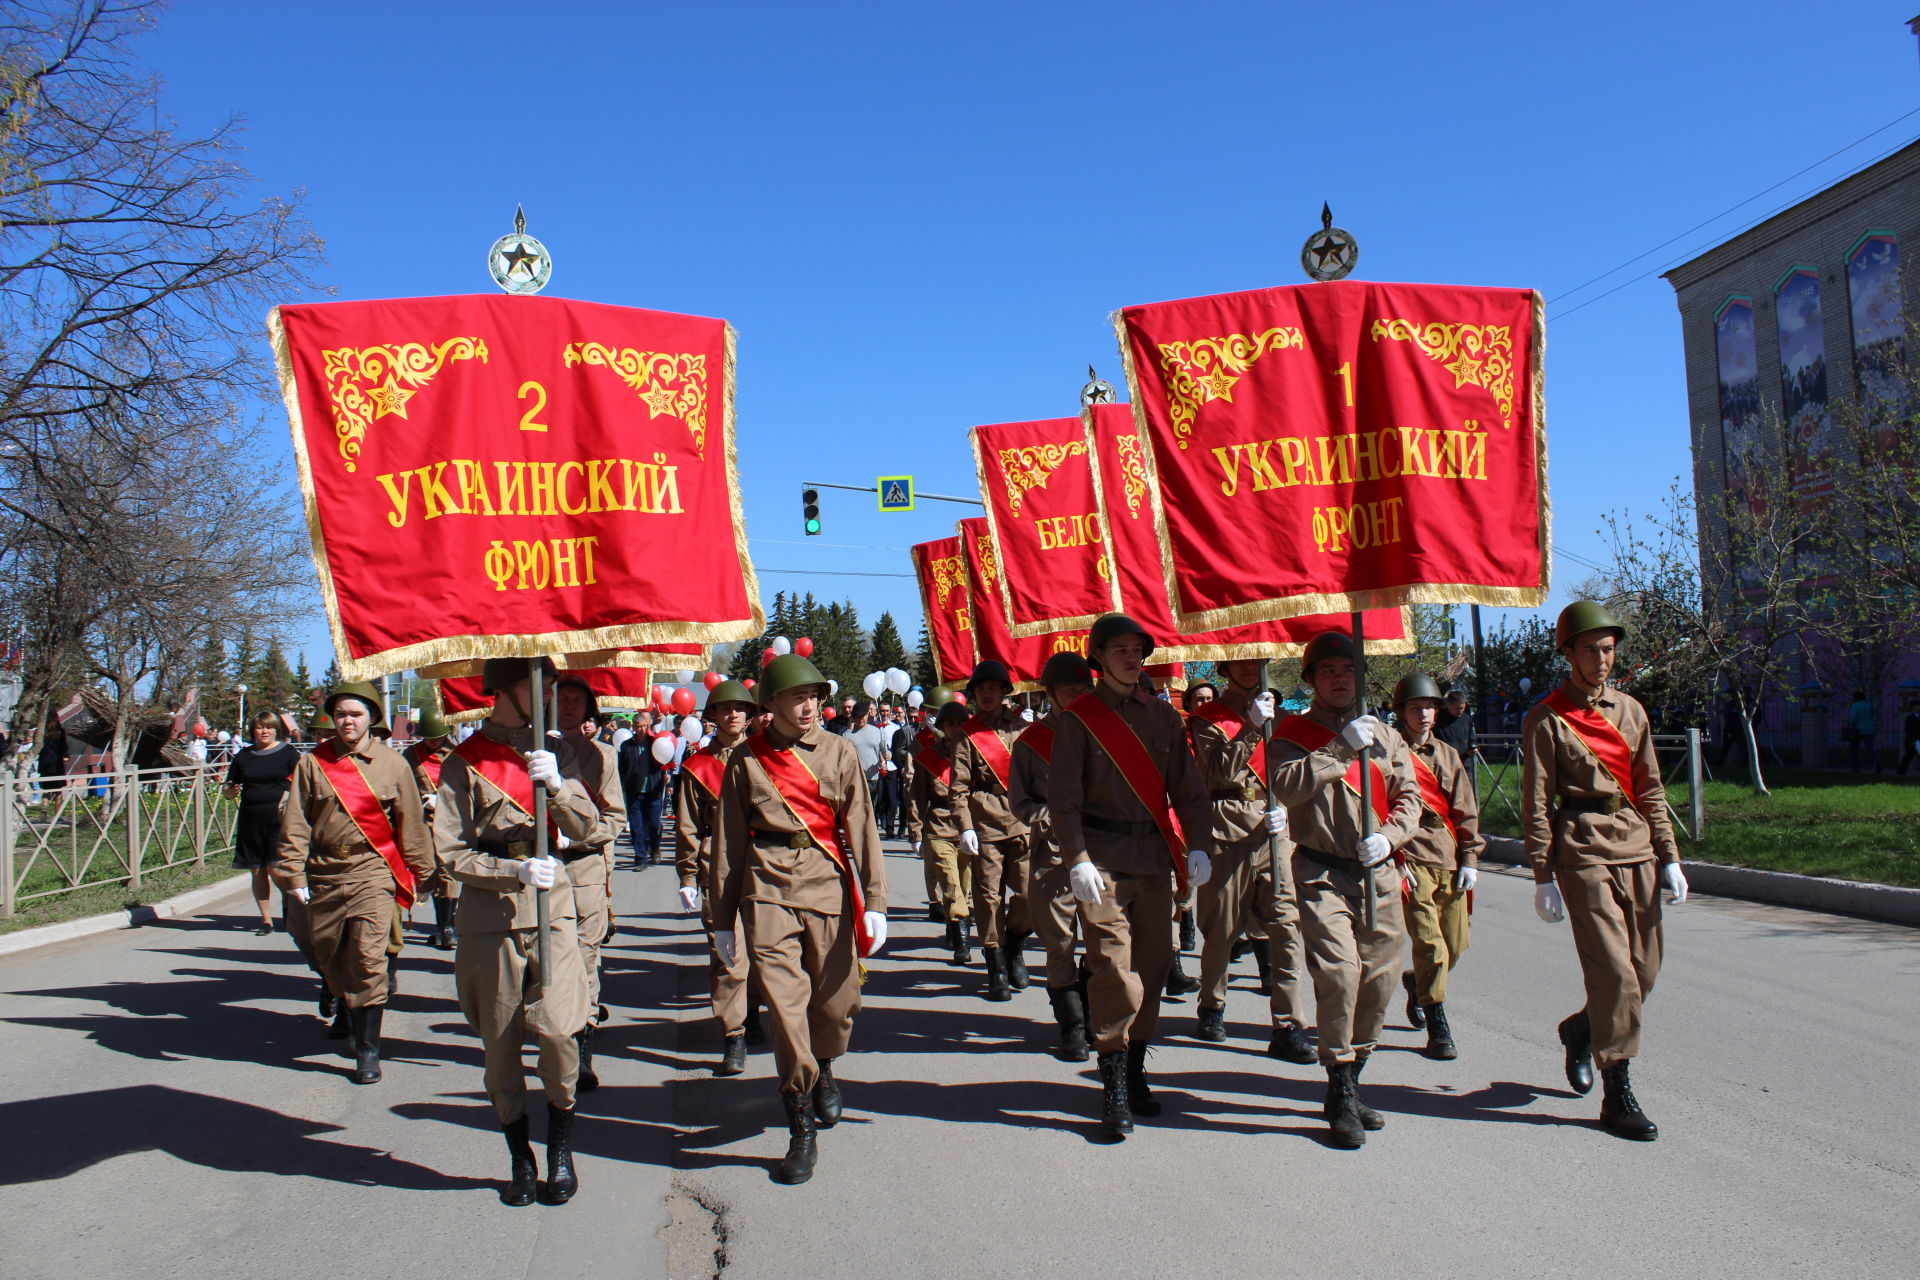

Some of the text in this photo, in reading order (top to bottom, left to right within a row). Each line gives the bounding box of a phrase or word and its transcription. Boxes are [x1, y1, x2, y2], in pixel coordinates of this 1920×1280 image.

[517, 381, 548, 432] 2
[1334, 361, 1353, 407] 1
[1211, 419, 1488, 497] УКРАИНСКИЙ
[376, 452, 685, 528] УКРАИНСКИЙ
[1312, 496, 1403, 553] ФРОНТ
[484, 535, 599, 591] ФРОНТ
